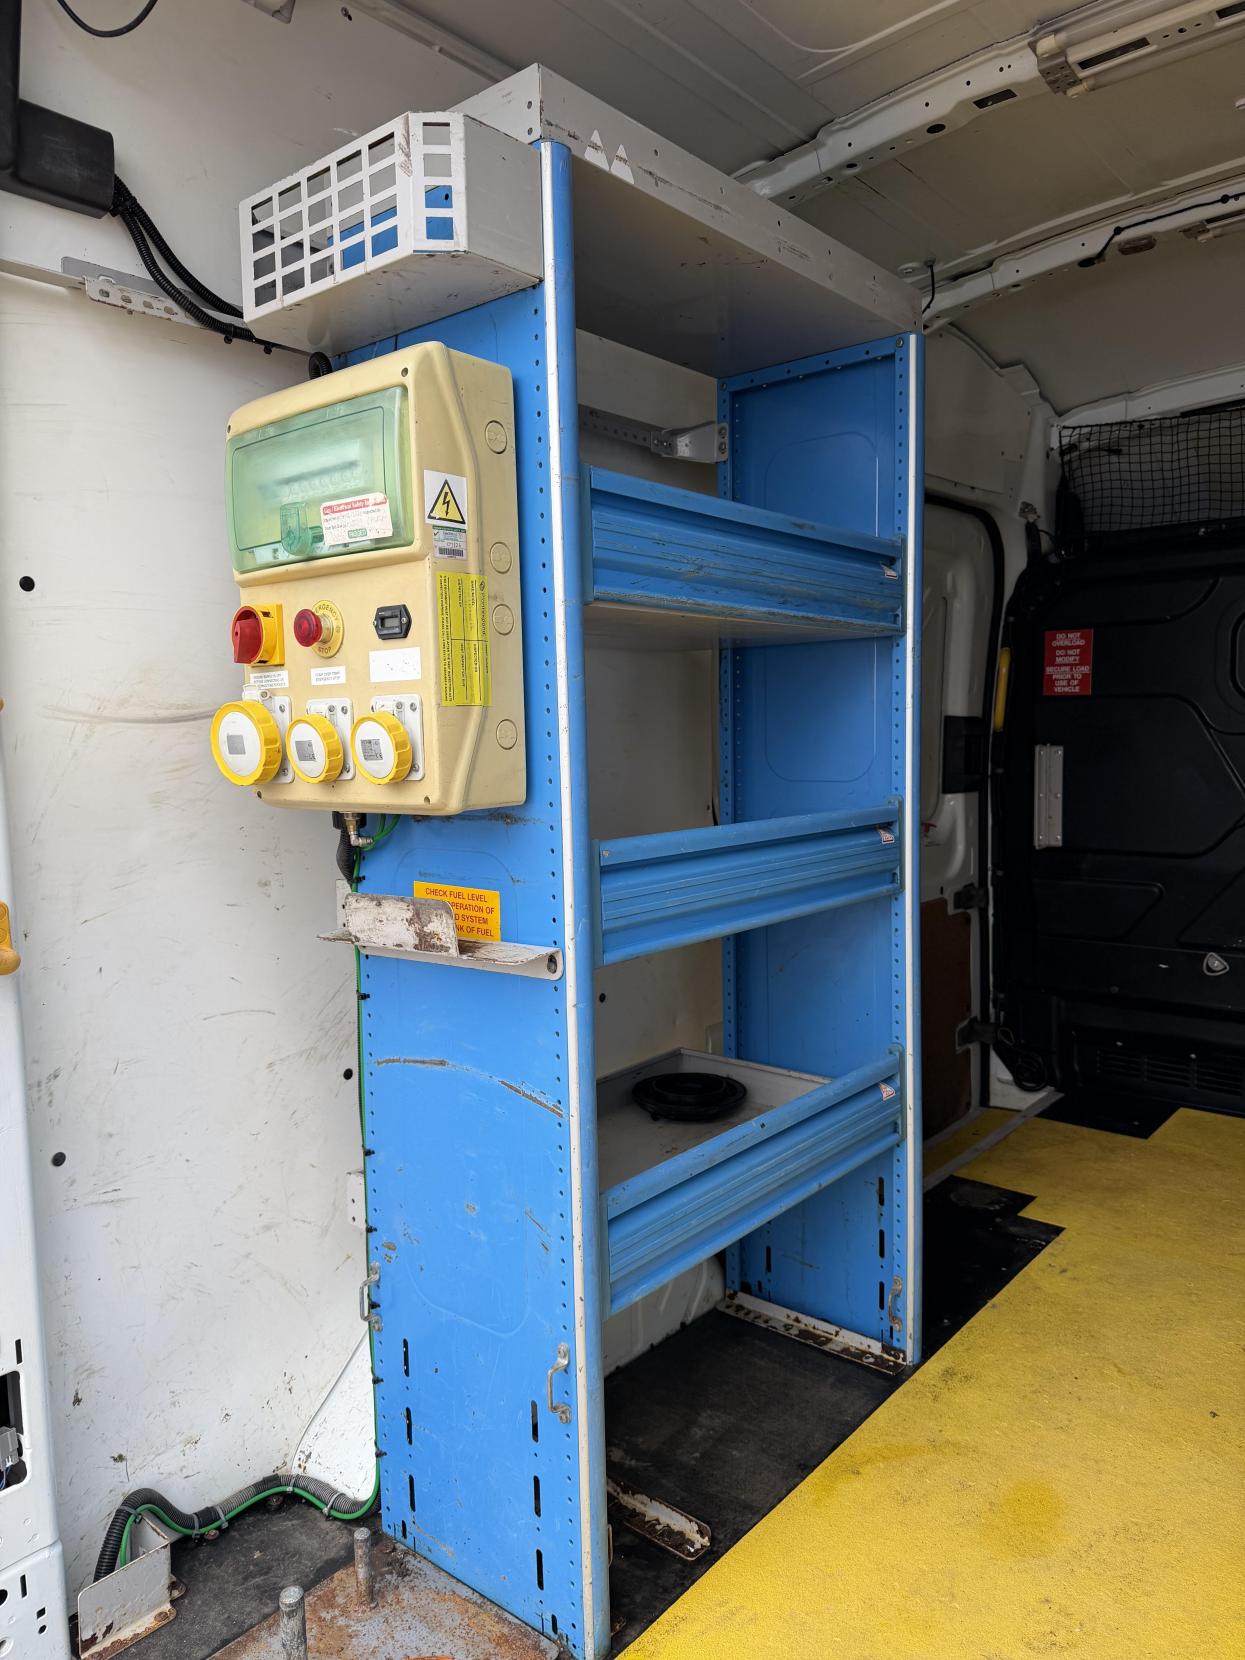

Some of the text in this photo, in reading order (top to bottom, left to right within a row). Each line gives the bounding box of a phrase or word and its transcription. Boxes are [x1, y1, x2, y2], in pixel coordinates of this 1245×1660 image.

[315, 603, 339, 621] ERGENCY
[317, 646, 332, 654] STOP
[425, 887, 488, 903] CHECK FUEL LEVEL
[485, 906, 495, 915] OF
[461, 914, 489, 925] SYSTEM
[466, 926, 476, 934] OF
[476, 928, 494, 938] FUEL
